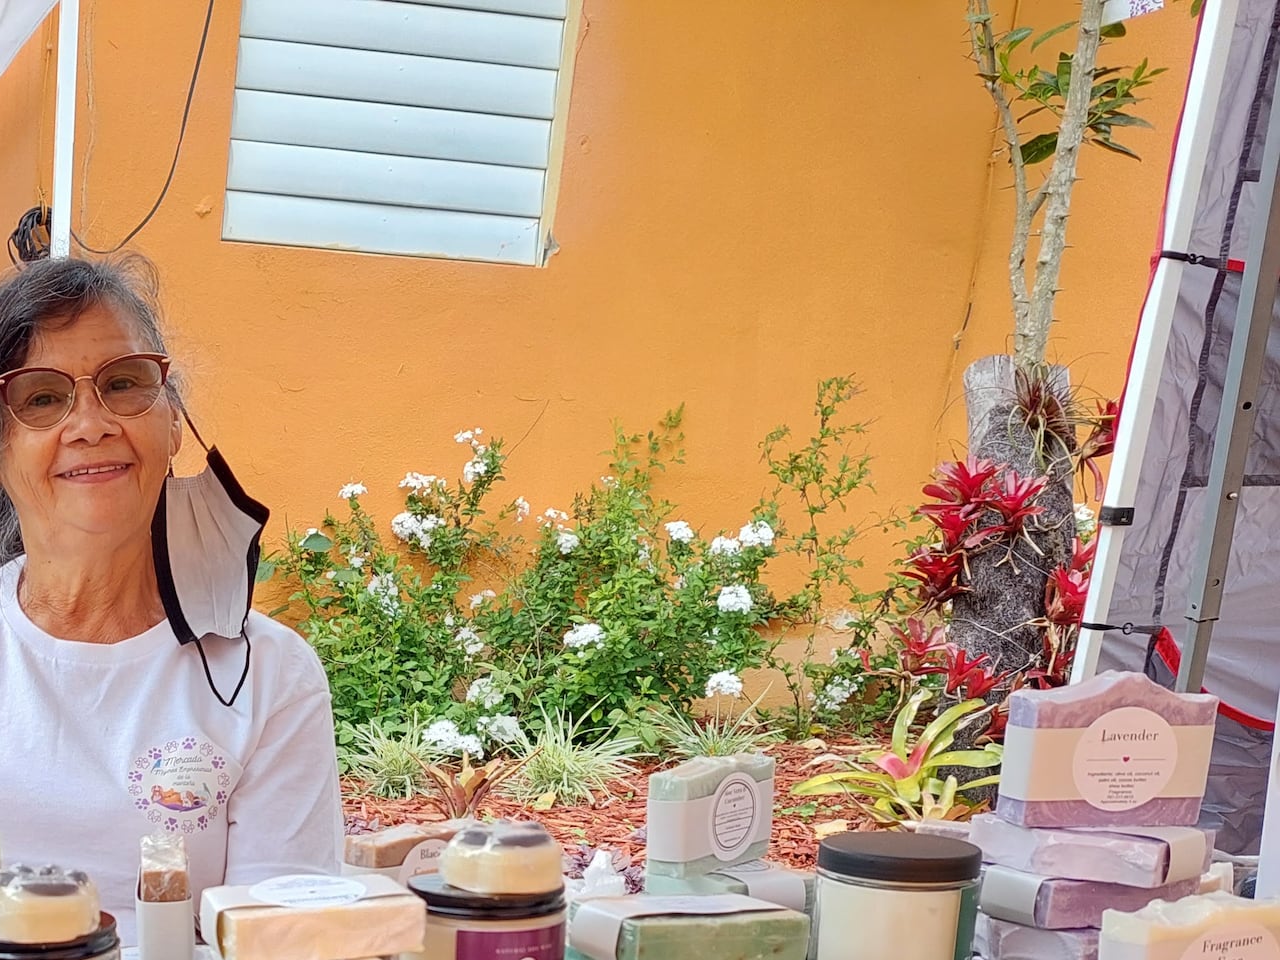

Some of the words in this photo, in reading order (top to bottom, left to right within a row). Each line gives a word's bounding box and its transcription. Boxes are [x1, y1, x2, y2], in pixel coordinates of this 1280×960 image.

[1101, 729, 1159, 742] Lavender
[163, 756, 202, 767] Mercado
[1203, 936, 1263, 954] Fragrance
